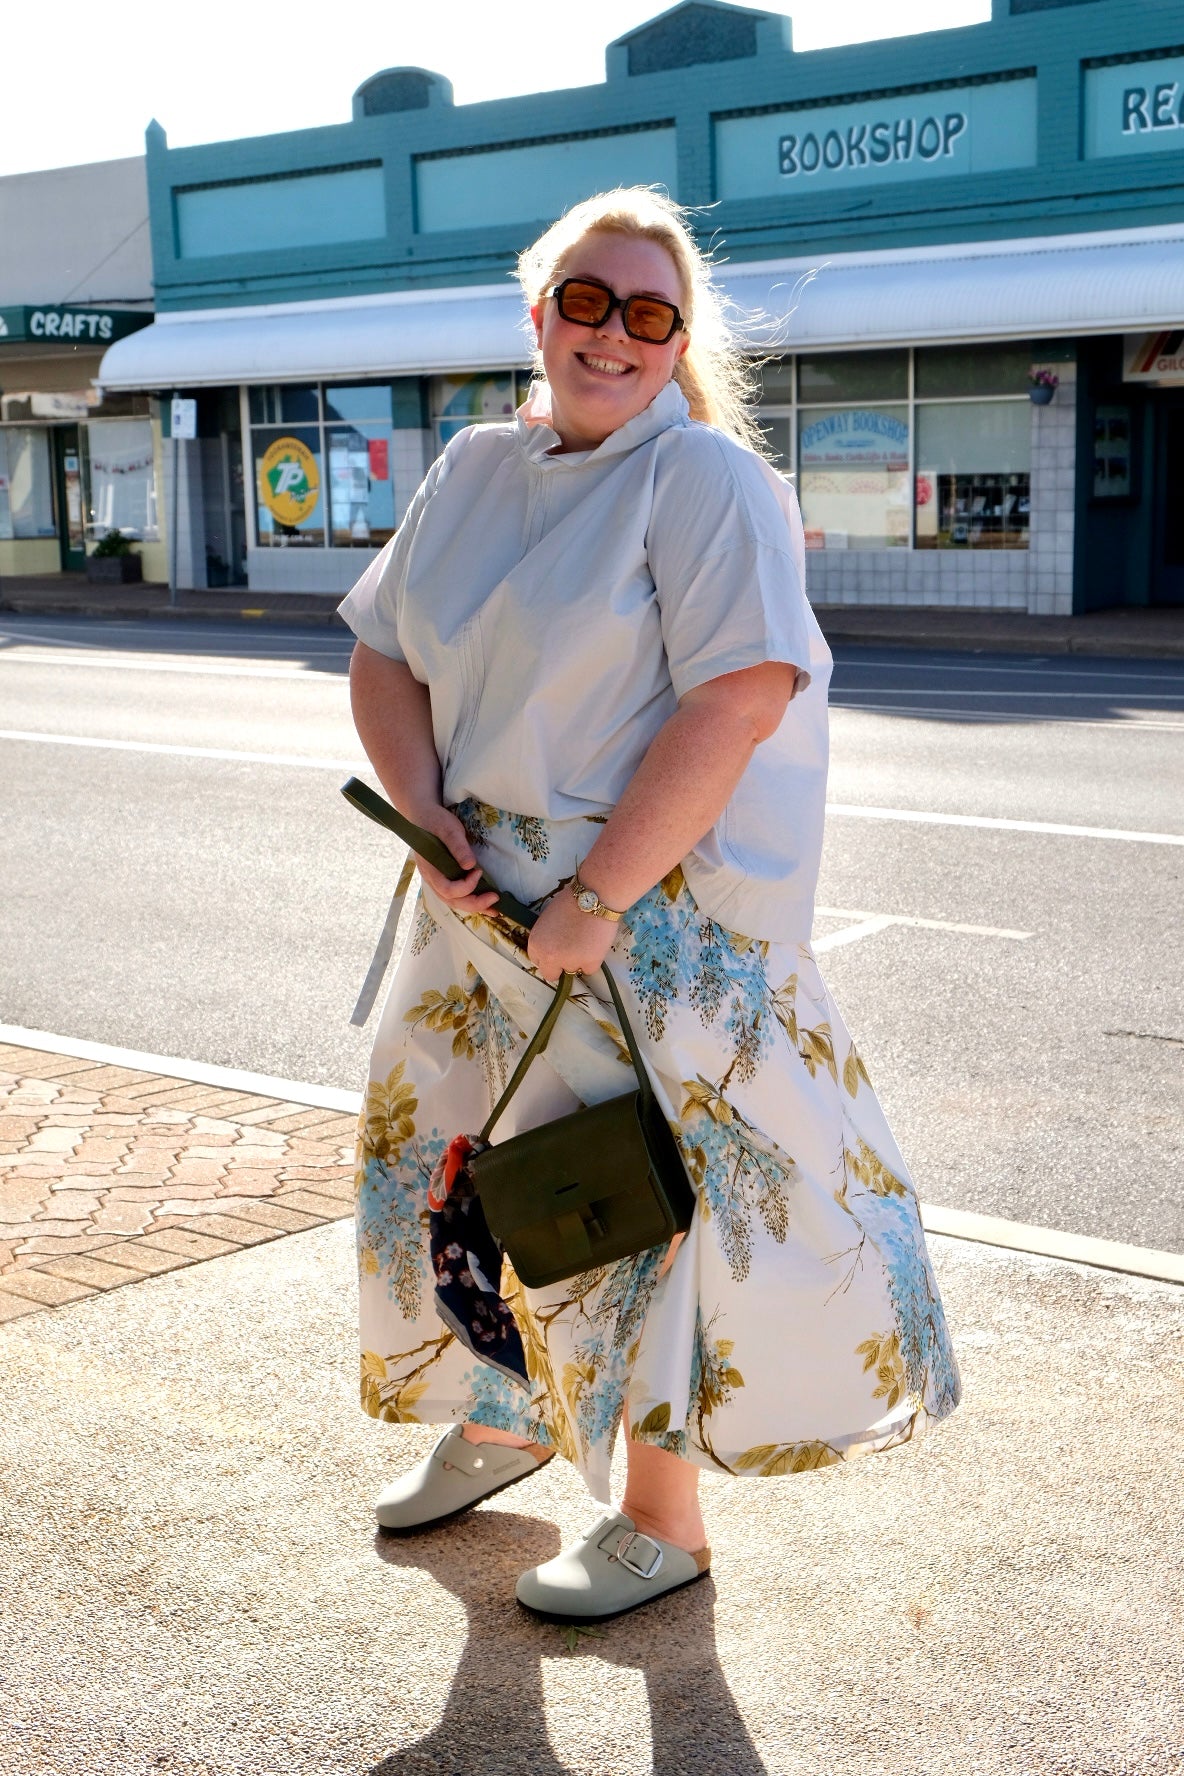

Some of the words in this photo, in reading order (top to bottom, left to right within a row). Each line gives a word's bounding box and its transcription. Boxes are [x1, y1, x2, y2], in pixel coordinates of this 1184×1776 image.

[778, 112, 967, 178] BOOKSHOP
[30, 311, 113, 338] CRAFTS
[803, 412, 850, 449] OPENWAY
[853, 411, 909, 445] BOOKSHOP
[275, 462, 305, 494] TP
